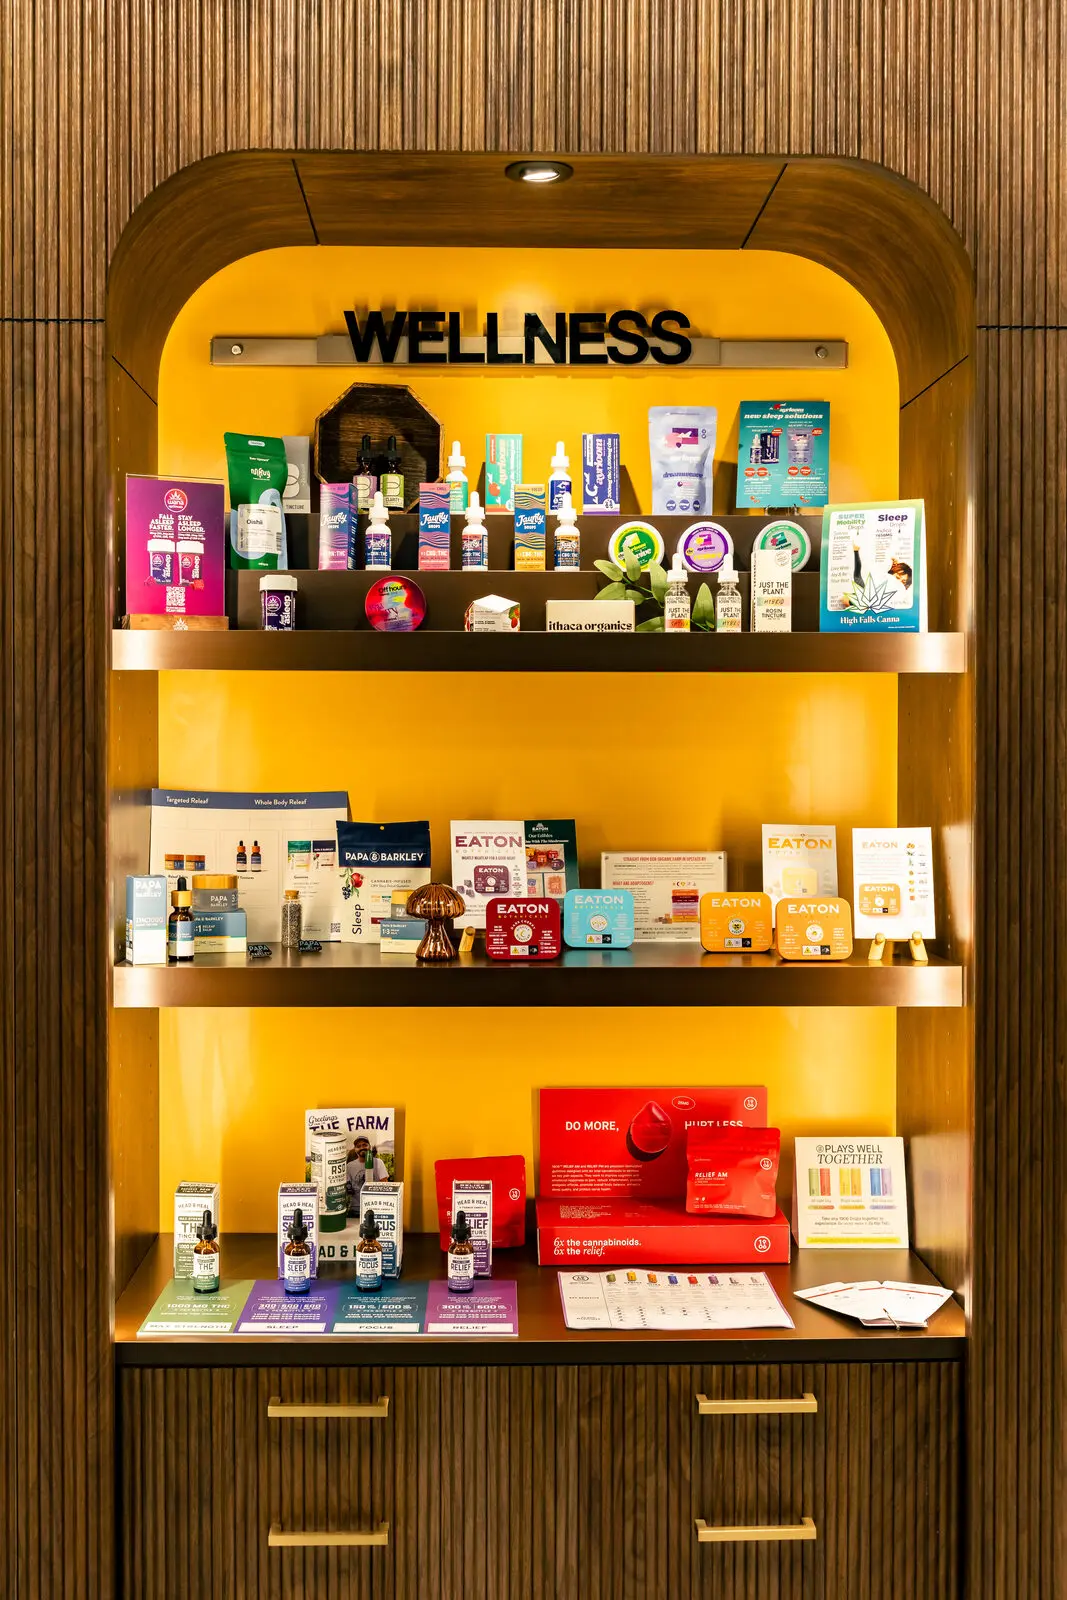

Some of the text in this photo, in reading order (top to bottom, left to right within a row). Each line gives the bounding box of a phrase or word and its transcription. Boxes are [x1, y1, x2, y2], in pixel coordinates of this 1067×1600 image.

[344, 309, 692, 365] WELLNESS
[420, 511, 449, 526] Jaunty
[516, 511, 545, 527] Jaunty
[878, 513, 908, 522] Sleep
[178, 525, 206, 533] LONGER.
[840, 615, 900, 627] High Falls Canna
[549, 621, 632, 632] ithaca organics
[166, 796, 190, 804] Targeted
[273, 799, 288, 807] Body
[455, 836, 523, 848] EATON
[768, 837, 832, 849] EATON
[862, 841, 898, 849] EATON
[345, 852, 369, 861] PAPA
[381, 852, 424, 861] BARKLEY
[135, 881, 162, 889] PAPA
[574, 895, 624, 904] EATON
[711, 898, 761, 907] EATON
[497, 904, 549, 914] EATON
[788, 904, 840, 914] EATON
[352, 904, 365, 935] Sleep
[308, 1114, 338, 1126] Greetings
[346, 1115, 389, 1131] FARM
[565, 1121, 581, 1131] DO
[584, 1121, 619, 1132] MORE,
[825, 1145, 883, 1153] PLAYS WELL
[817, 1154, 883, 1164] TOGETHER
[331, 1164, 346, 1174] RSO
[378, 1221, 395, 1231] CUS
[553, 1237, 642, 1247] 6x the cannabinoids.
[318, 1245, 349, 1258] AD &
[553, 1246, 606, 1257] 6x the relief.
[198, 1262, 214, 1271] THC
[288, 1264, 307, 1272] SLEEP
[358, 1261, 379, 1269] FOCUS
[451, 1263, 471, 1271] RELIEF
